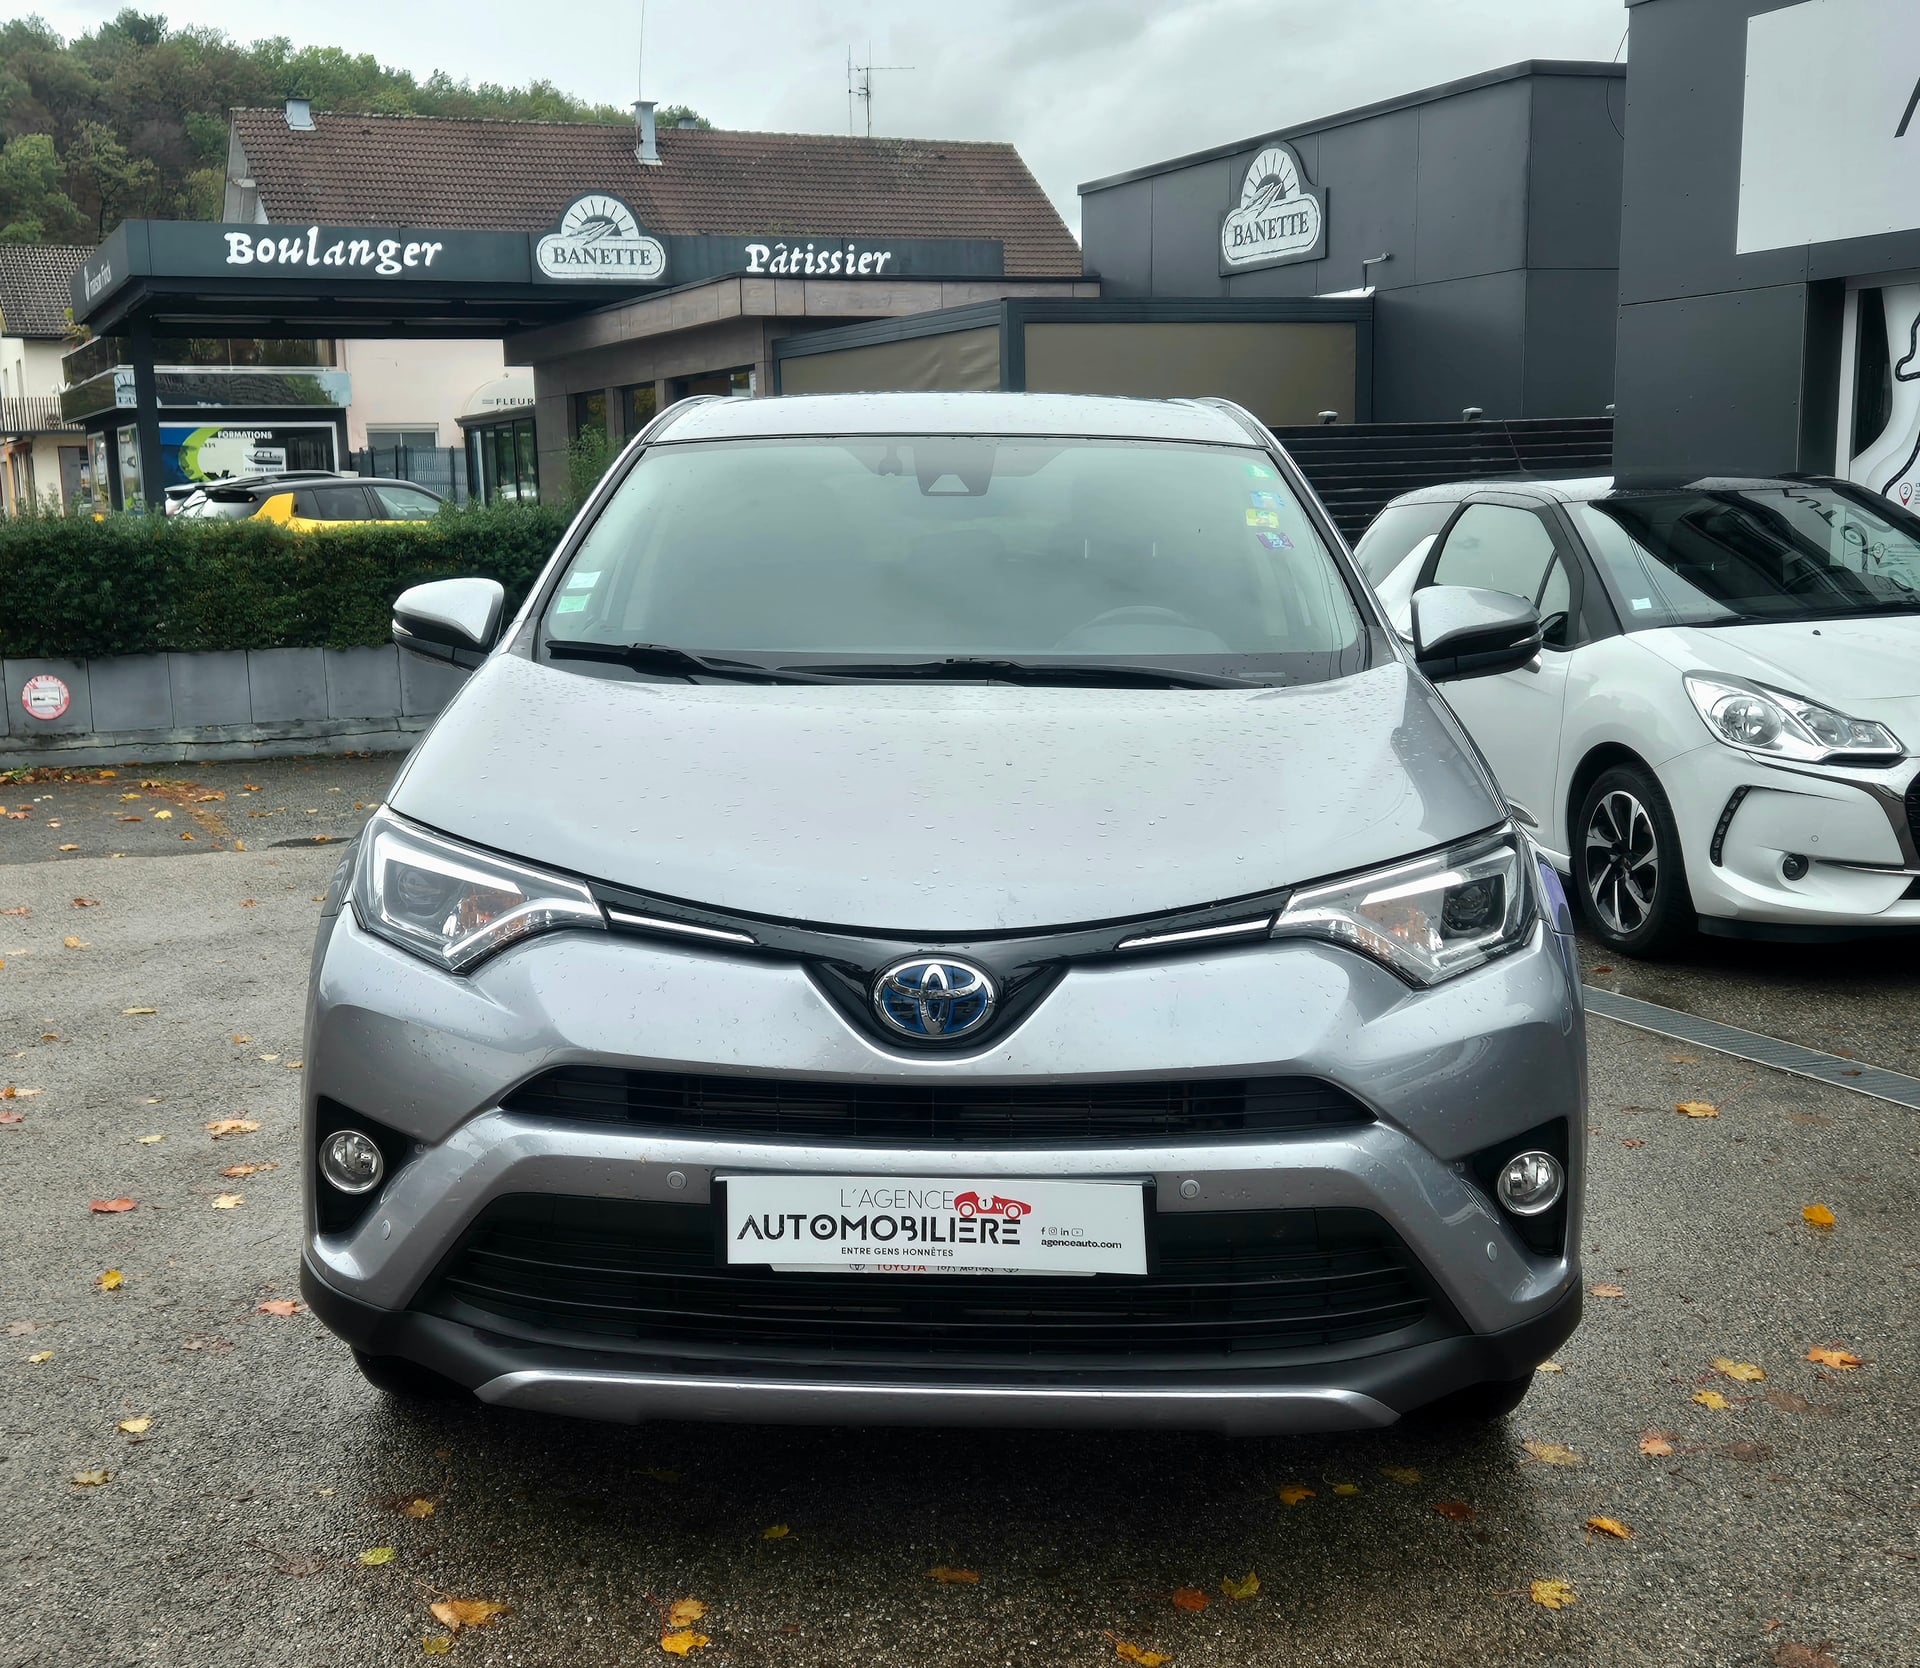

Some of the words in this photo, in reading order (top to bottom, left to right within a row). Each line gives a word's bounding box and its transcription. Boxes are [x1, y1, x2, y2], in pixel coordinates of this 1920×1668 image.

[1232, 211, 1310, 247] BANETTE
[224, 226, 443, 275] Boulanger
[551, 245, 652, 267] BANETTE
[744, 242, 892, 275] Pâtissier
[217, 430, 273, 440] FORMATIONS
[840, 1188, 954, 1210] L'AGENCE
[841, 1246, 872, 1255] ENTRE
[874, 1247, 900, 1256] GENS
[902, 1246, 954, 1257] HONNÊTES
[1040, 1239, 1122, 1249] agenceauto.com
